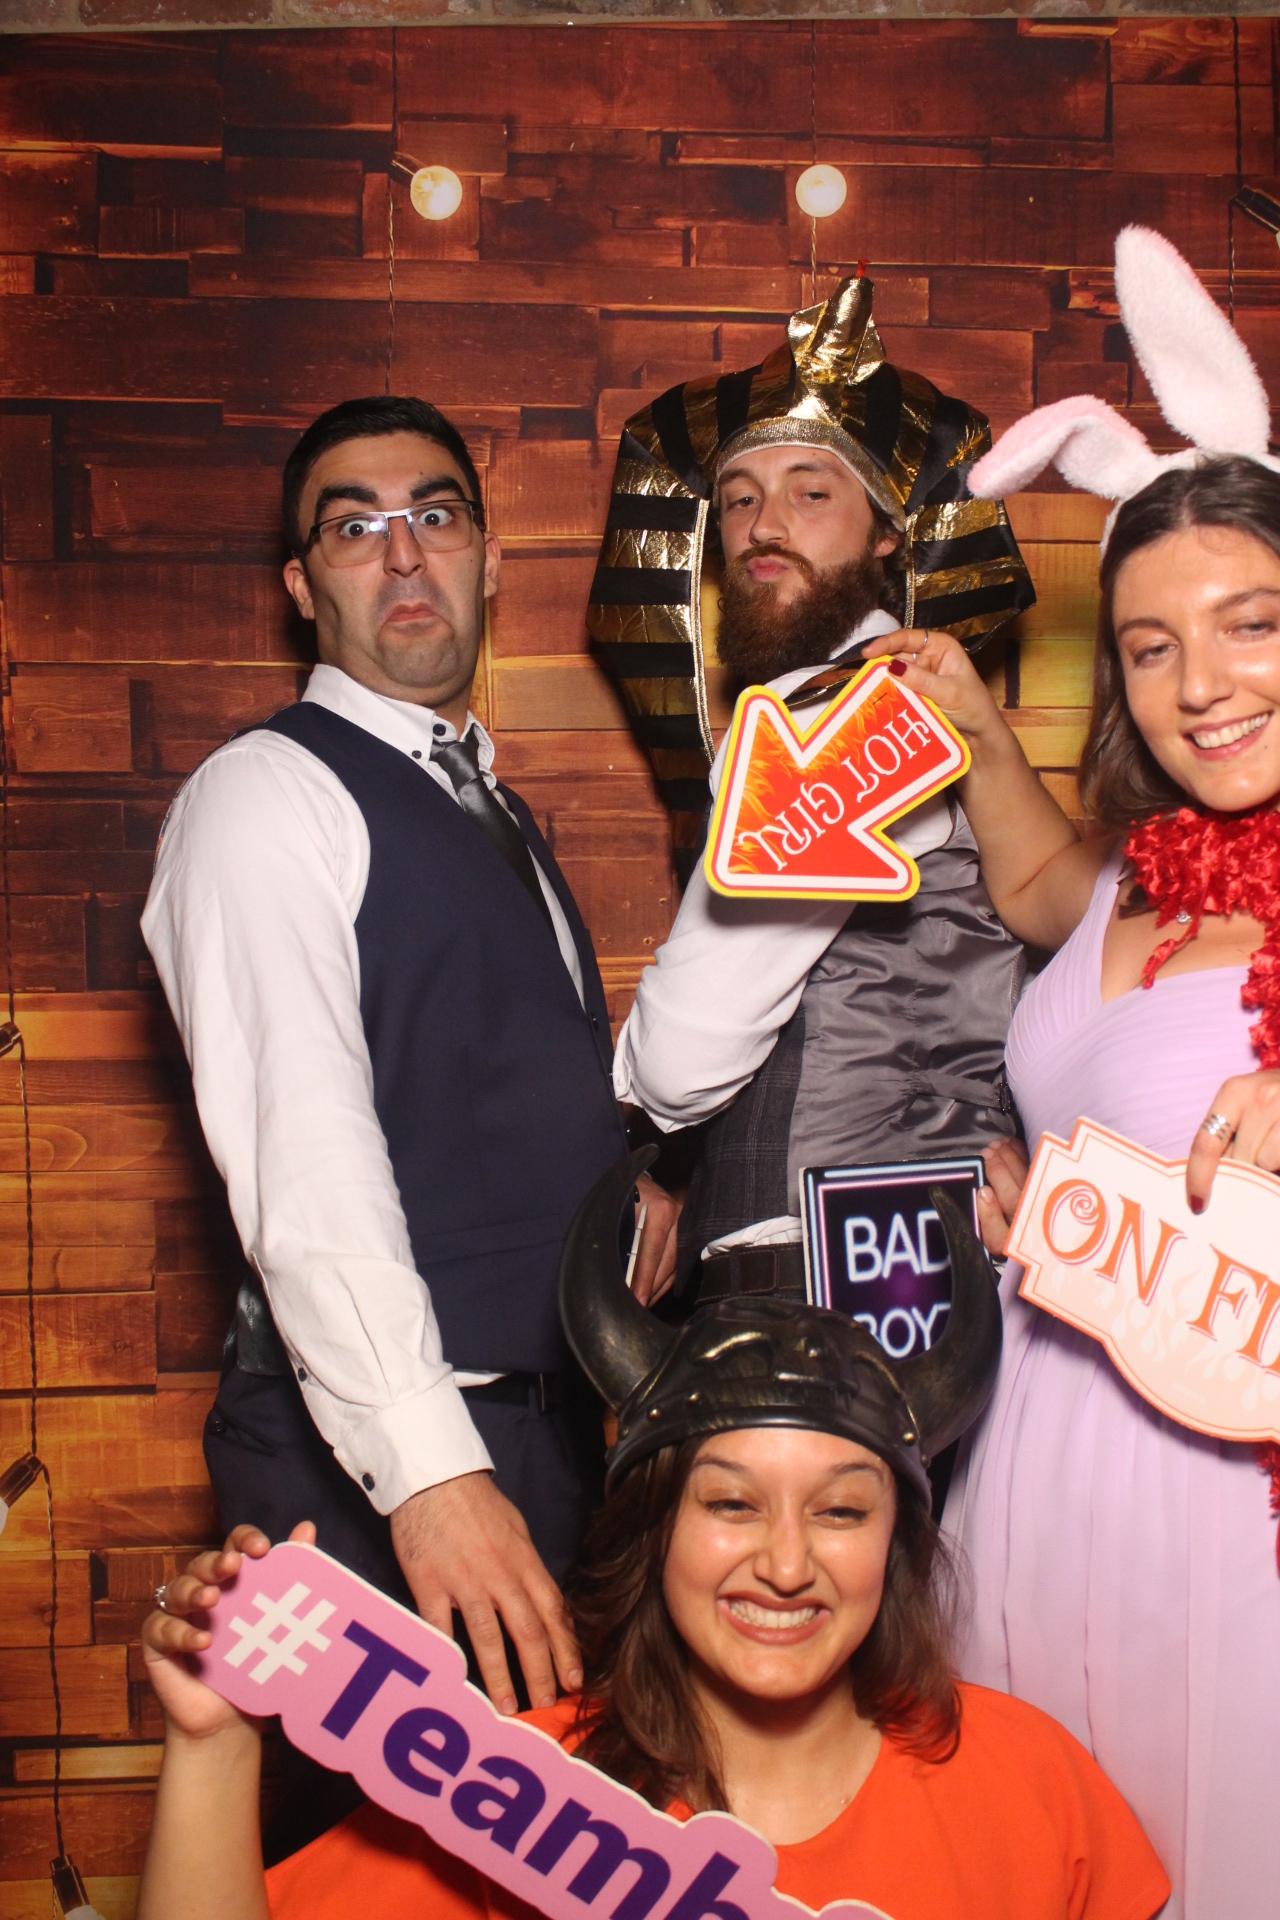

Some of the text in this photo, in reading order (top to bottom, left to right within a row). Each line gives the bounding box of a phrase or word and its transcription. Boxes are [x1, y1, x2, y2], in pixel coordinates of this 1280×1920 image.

[737, 709, 931, 872] HOT GIRL
[844, 1210, 951, 1283] BAD
[1042, 1178, 1280, 1377] ON FI
[852, 1303, 951, 1359] OY
